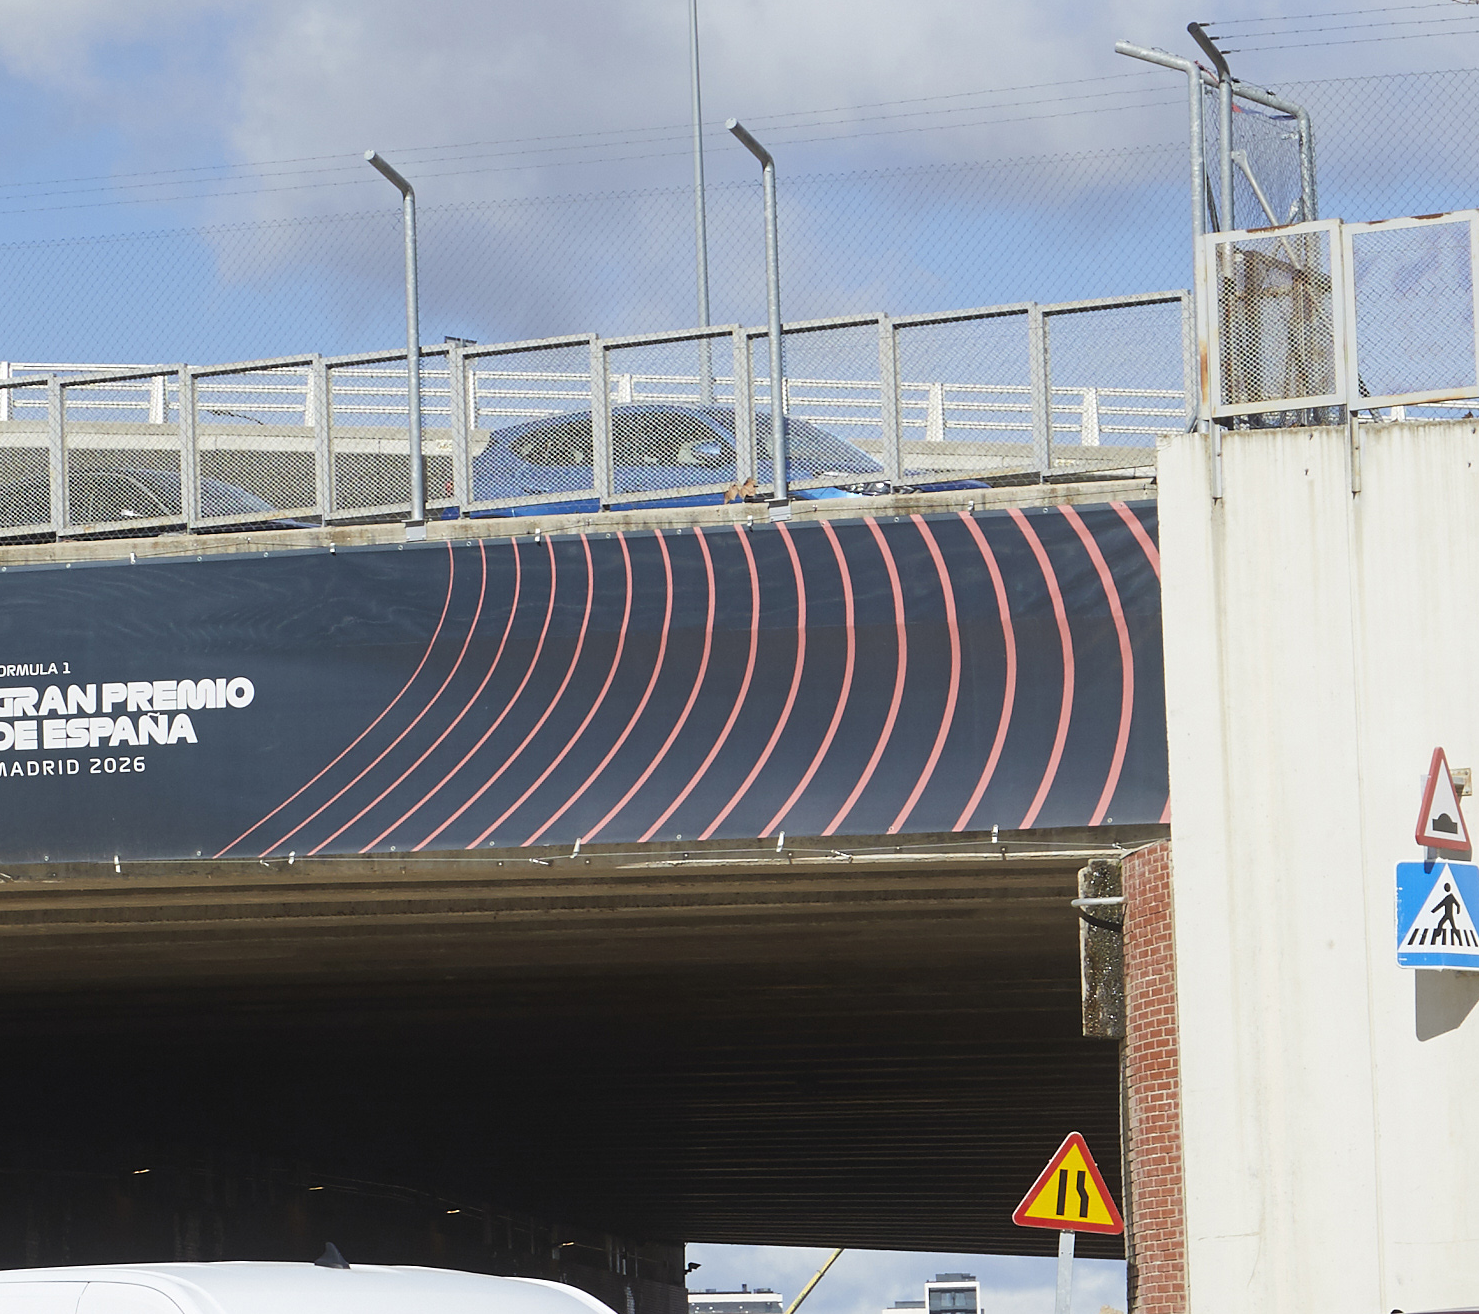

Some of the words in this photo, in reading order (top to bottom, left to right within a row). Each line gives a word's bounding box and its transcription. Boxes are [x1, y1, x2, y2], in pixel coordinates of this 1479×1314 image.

[62, 662, 71, 674] 1
[102, 676, 255, 713] PREMIO
[42, 712, 198, 750] ESPAÑA
[89, 756, 146, 774] 2026
